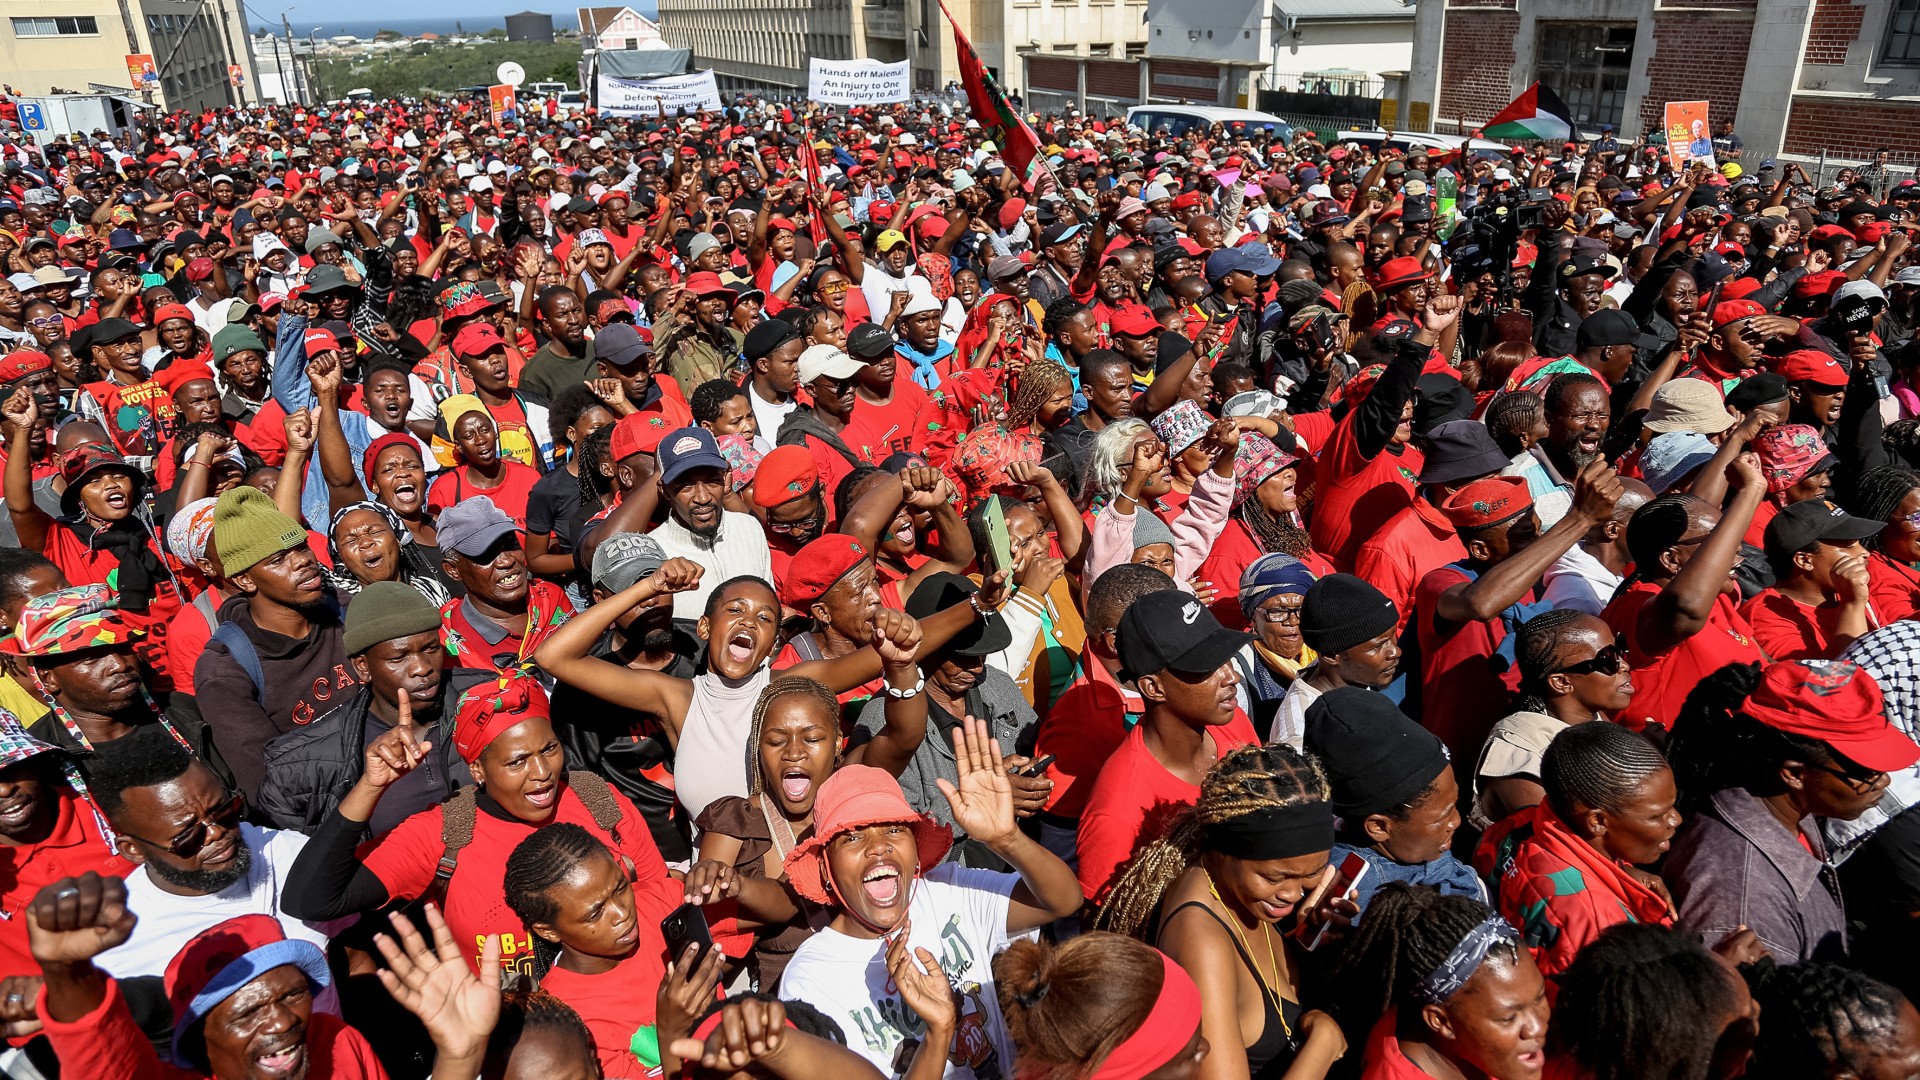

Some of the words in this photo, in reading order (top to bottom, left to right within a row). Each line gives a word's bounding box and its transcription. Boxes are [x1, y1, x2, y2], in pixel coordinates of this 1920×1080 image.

[819, 67, 851, 77] Hands
[853, 70, 868, 78] off
[869, 68, 904, 78] Malema!
[823, 79, 838, 88] An
[841, 81, 869, 92] Injury
[883, 81, 900, 89] One
[820, 88, 828, 96] is
[846, 91, 874, 100] Injury
[886, 89, 902, 98] All!
[622, 102, 657, 110] Defend
[662, 98, 711, 110] ourselves!
[24, 105, 35, 117] P
[1851, 305, 1867, 314] SABC
[1846, 310, 1869, 323] NEWS
[121, 390, 153, 405] VOTE
[1491, 498, 1508, 511] EFF
[1182, 600, 1199, 617] NIKE
